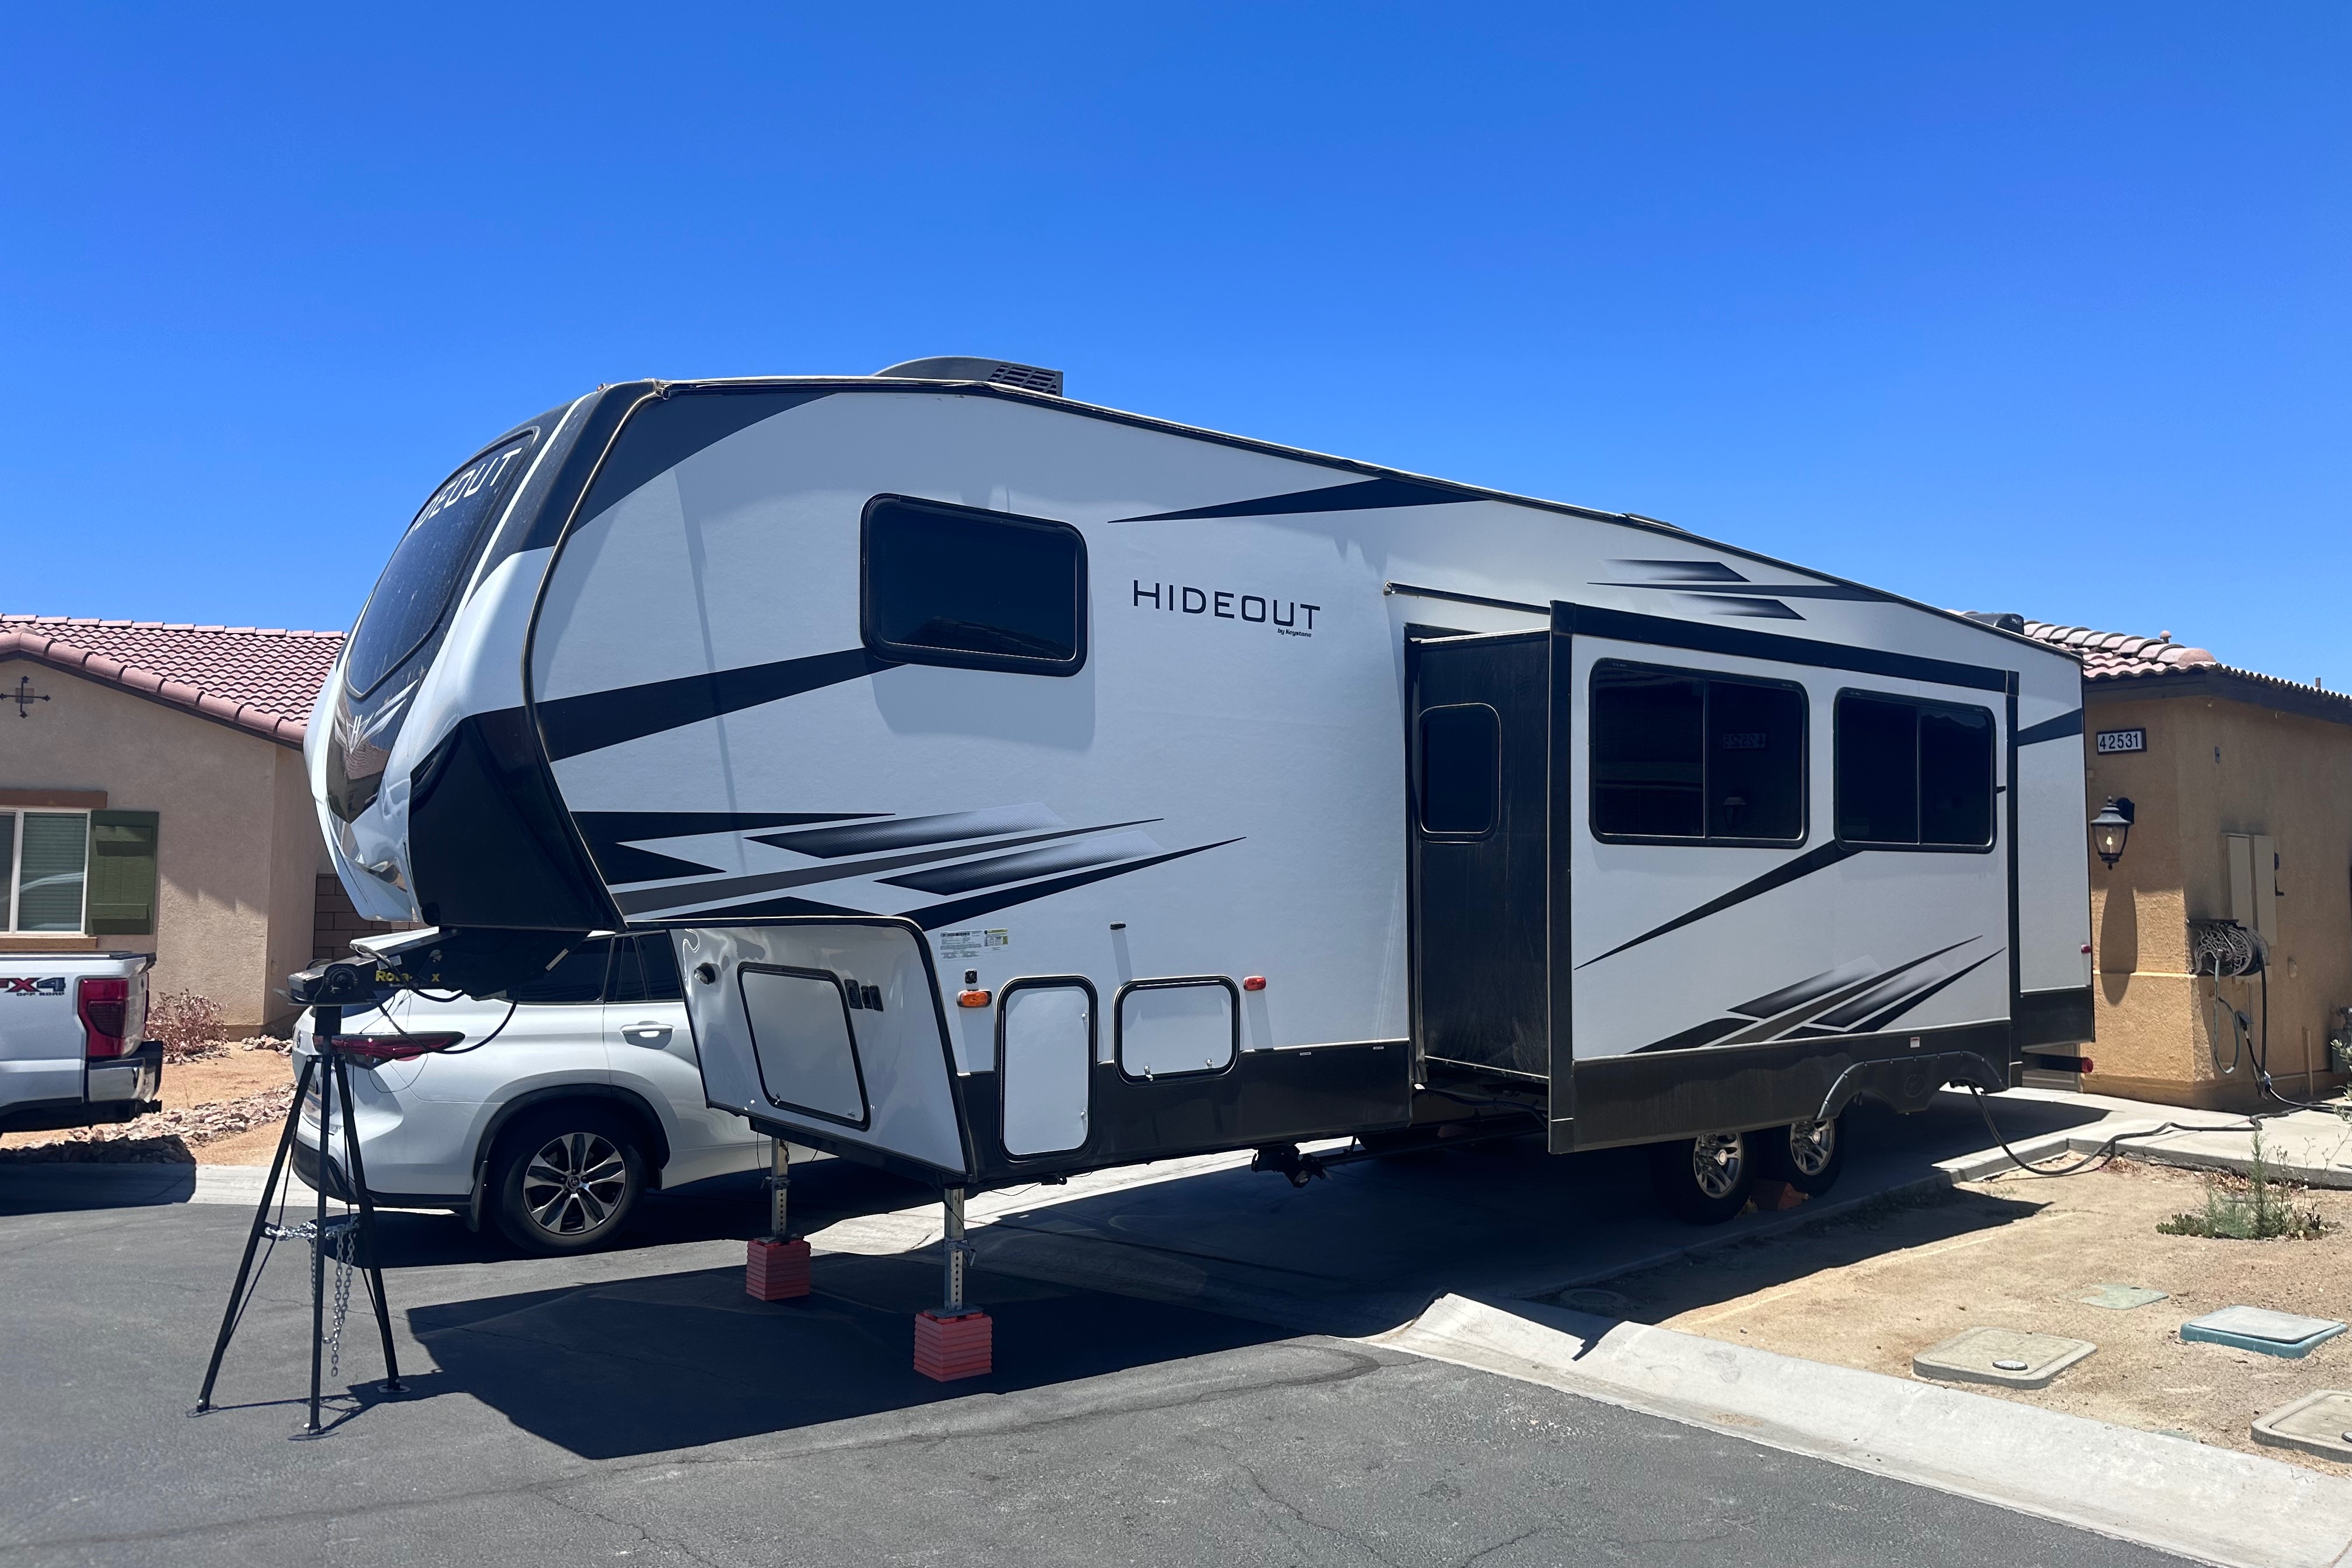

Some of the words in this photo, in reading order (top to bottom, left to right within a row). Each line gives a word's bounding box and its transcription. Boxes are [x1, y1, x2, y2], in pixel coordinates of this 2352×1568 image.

[1134, 580, 1320, 629] HIDEOUT
[1286, 629, 1312, 637] Keystone
[2099, 733, 2139, 750] 42531
